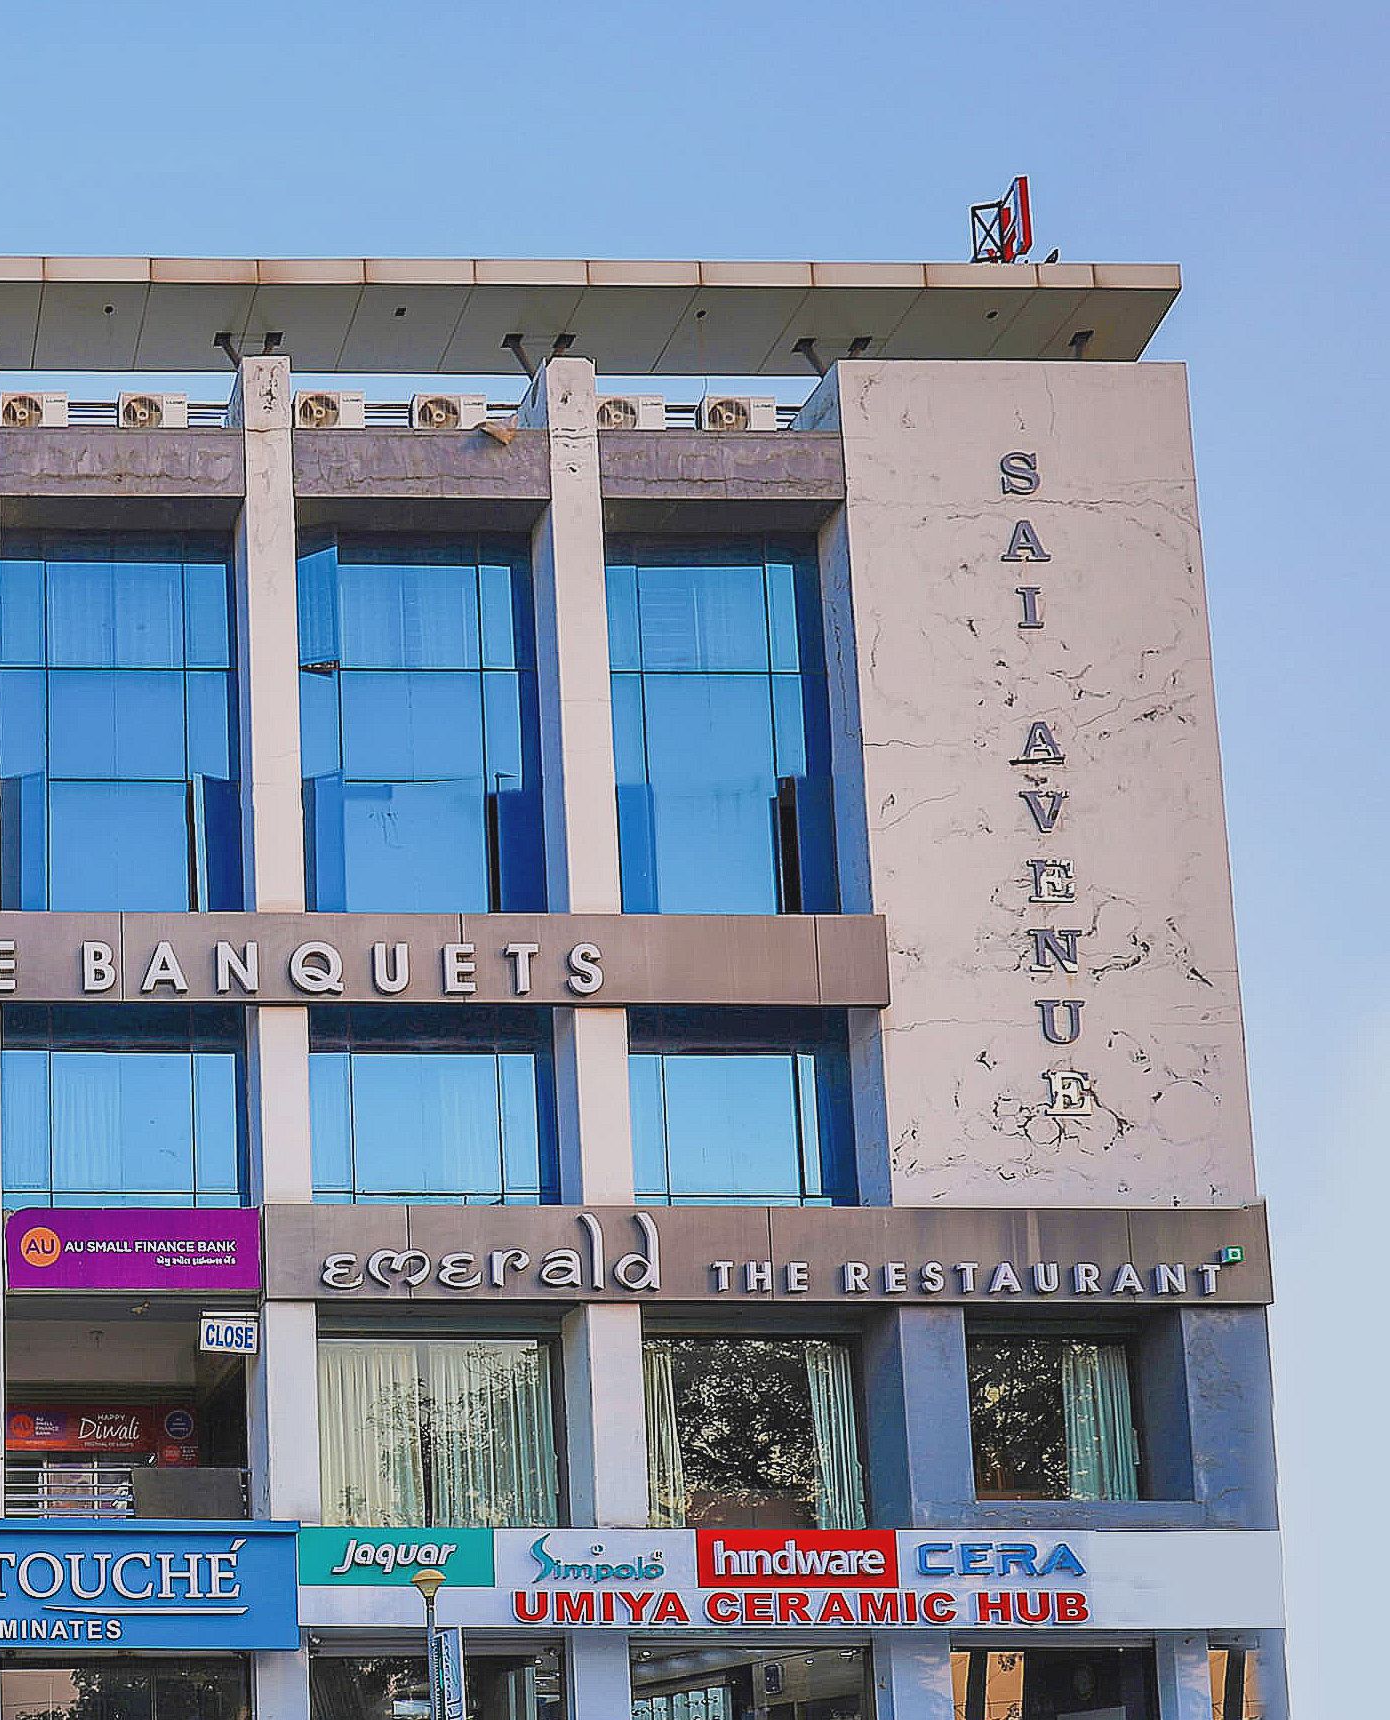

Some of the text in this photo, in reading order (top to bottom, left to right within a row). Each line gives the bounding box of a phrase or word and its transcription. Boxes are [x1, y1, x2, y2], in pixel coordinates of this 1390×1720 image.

[1000, 452, 1096, 1116] SAI AVENUE
[81, 940, 605, 997] BANQUETS
[25, 1238, 56, 1256] AU
[64, 1240, 237, 1254] AU SMALL FINANCE BANK
[321, 1212, 1222, 1294] emerald THE RESTAURANT
[205, 1324, 255, 1349] CLOSE
[77, 1416, 140, 1440] Diwali
[332, 1539, 457, 1575] Jaquar
[712, 1539, 886, 1576] hindware
[916, 1541, 1088, 1577] CERA
[513, 1589, 1090, 1625] UMIYA CERAMIC HUB
